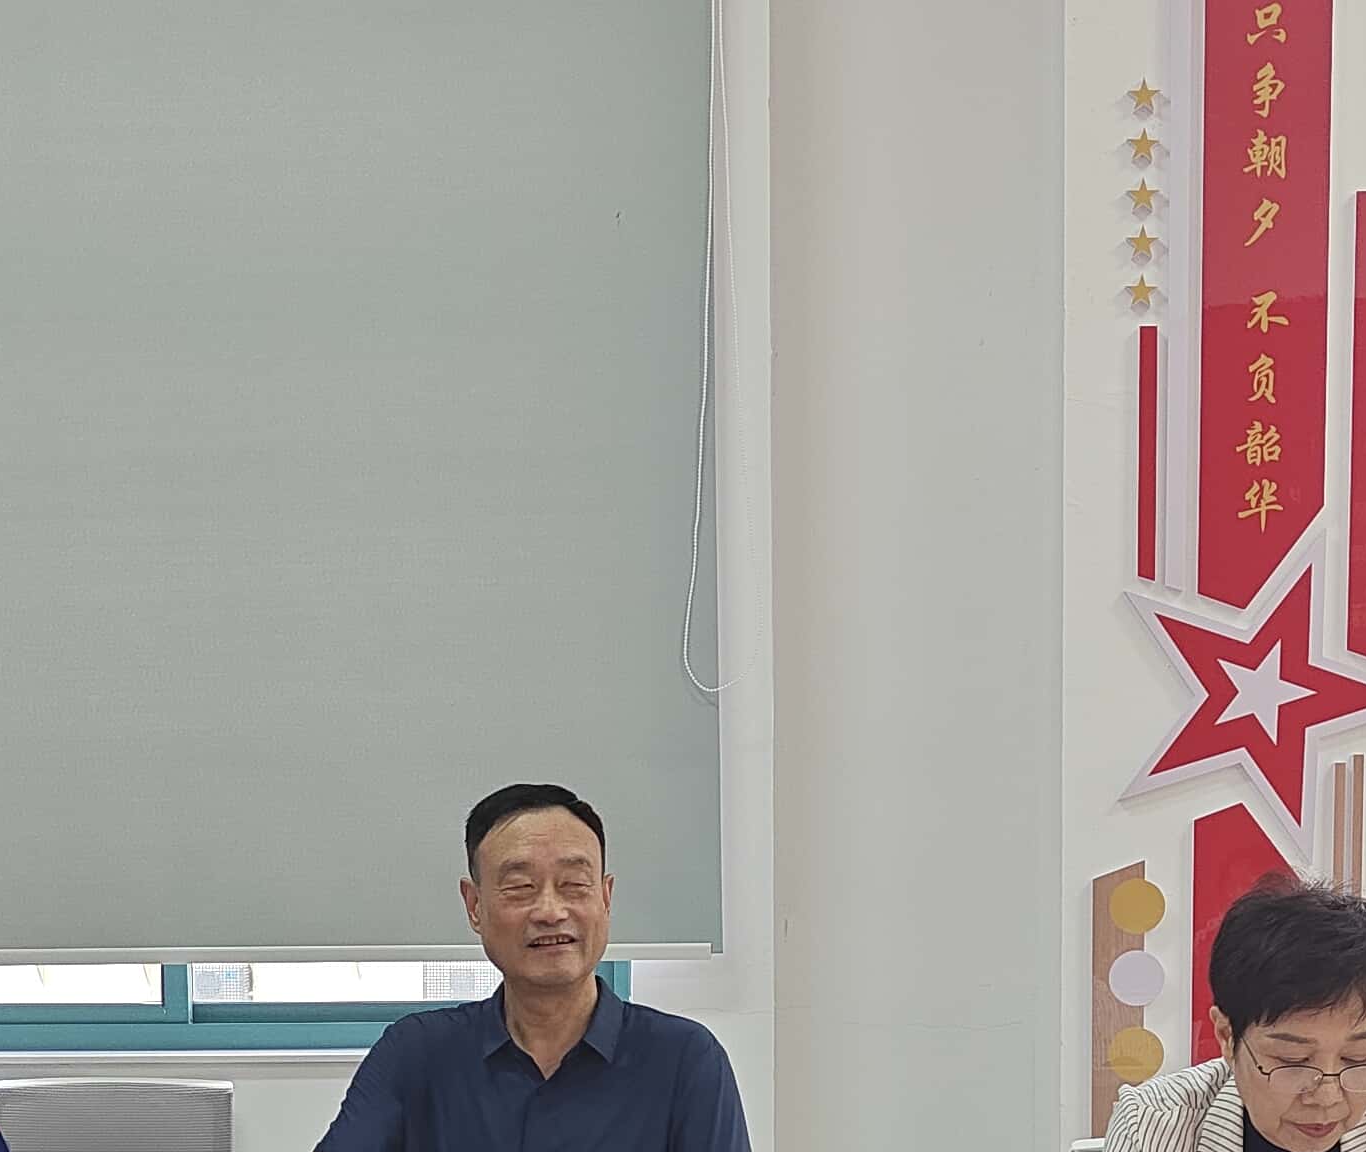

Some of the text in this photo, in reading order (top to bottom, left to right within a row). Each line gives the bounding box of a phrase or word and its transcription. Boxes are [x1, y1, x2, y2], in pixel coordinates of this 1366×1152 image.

[1235, 3, 1289, 533] 只争朝夕 不负韶华
